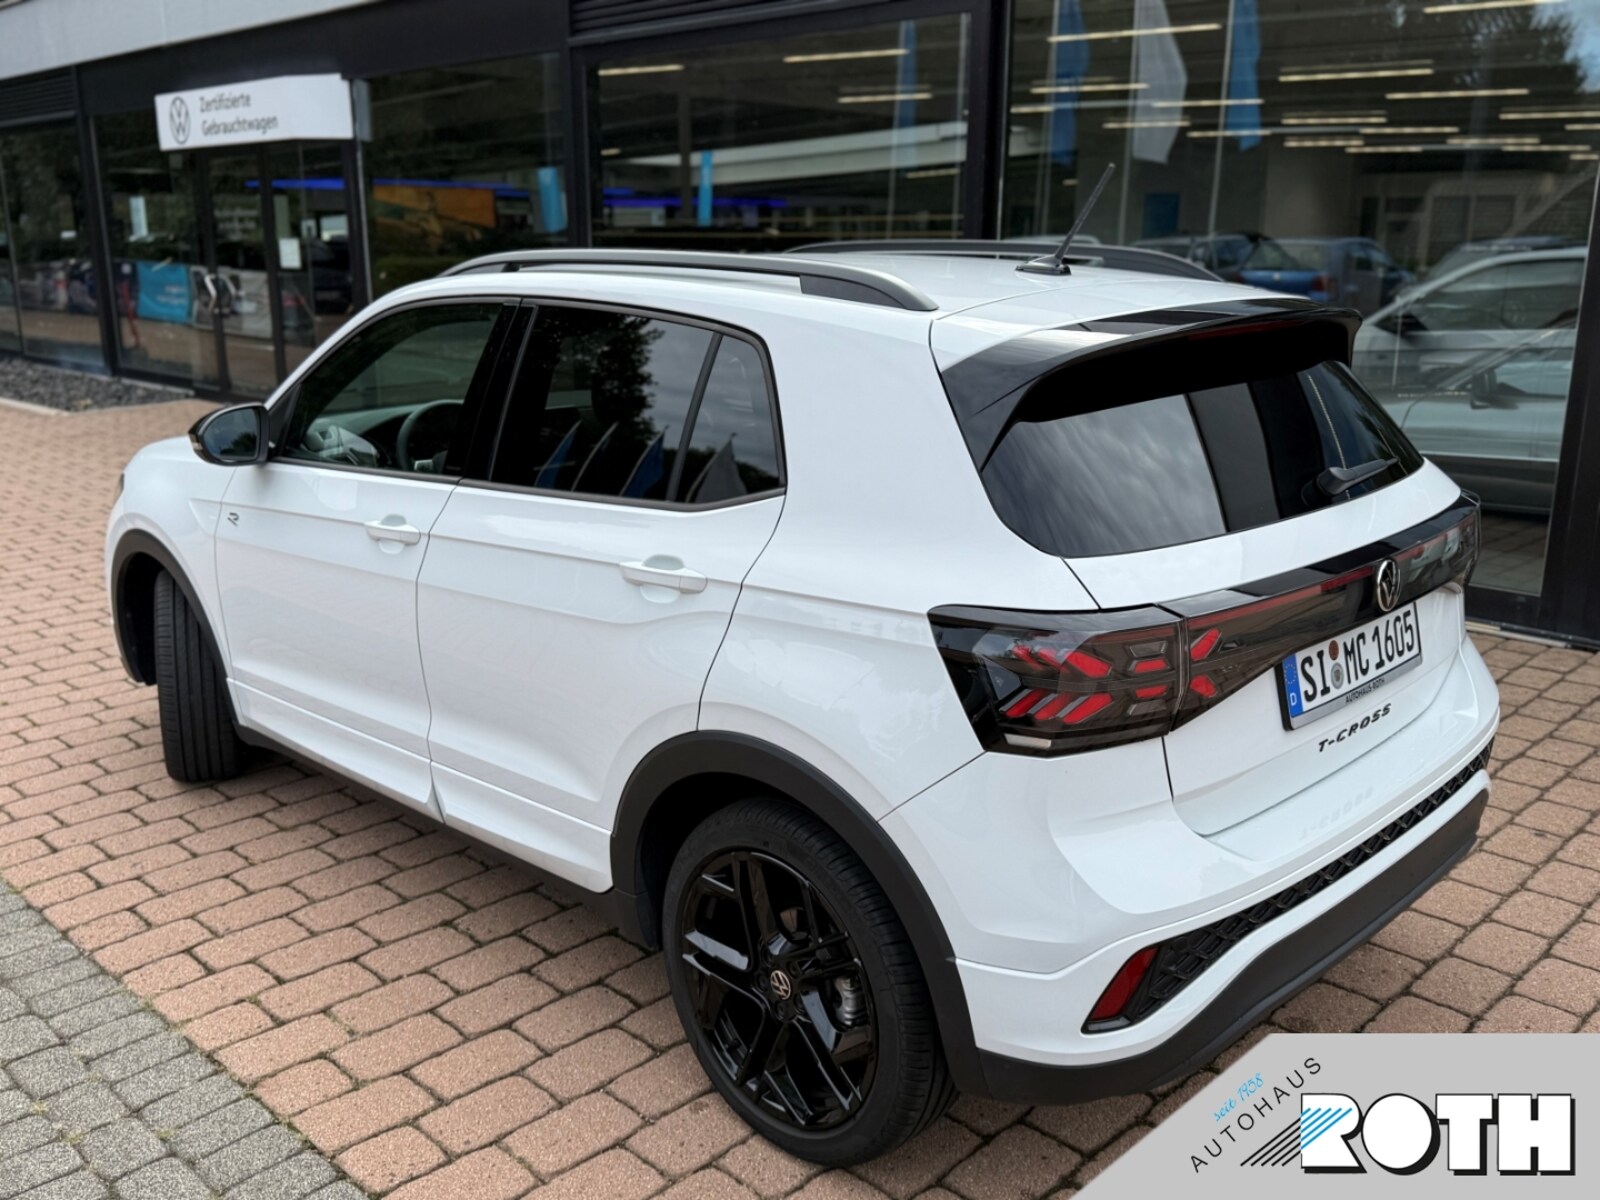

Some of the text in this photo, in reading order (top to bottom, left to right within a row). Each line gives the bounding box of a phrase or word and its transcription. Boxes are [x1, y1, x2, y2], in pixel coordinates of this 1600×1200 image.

[200, 93, 251, 113] Zertifizierte
[202, 115, 279, 136] Gebrauchtwagen
[1300, 609, 1415, 703] SI MC 1605
[1318, 703, 1392, 752] T-CROSS
